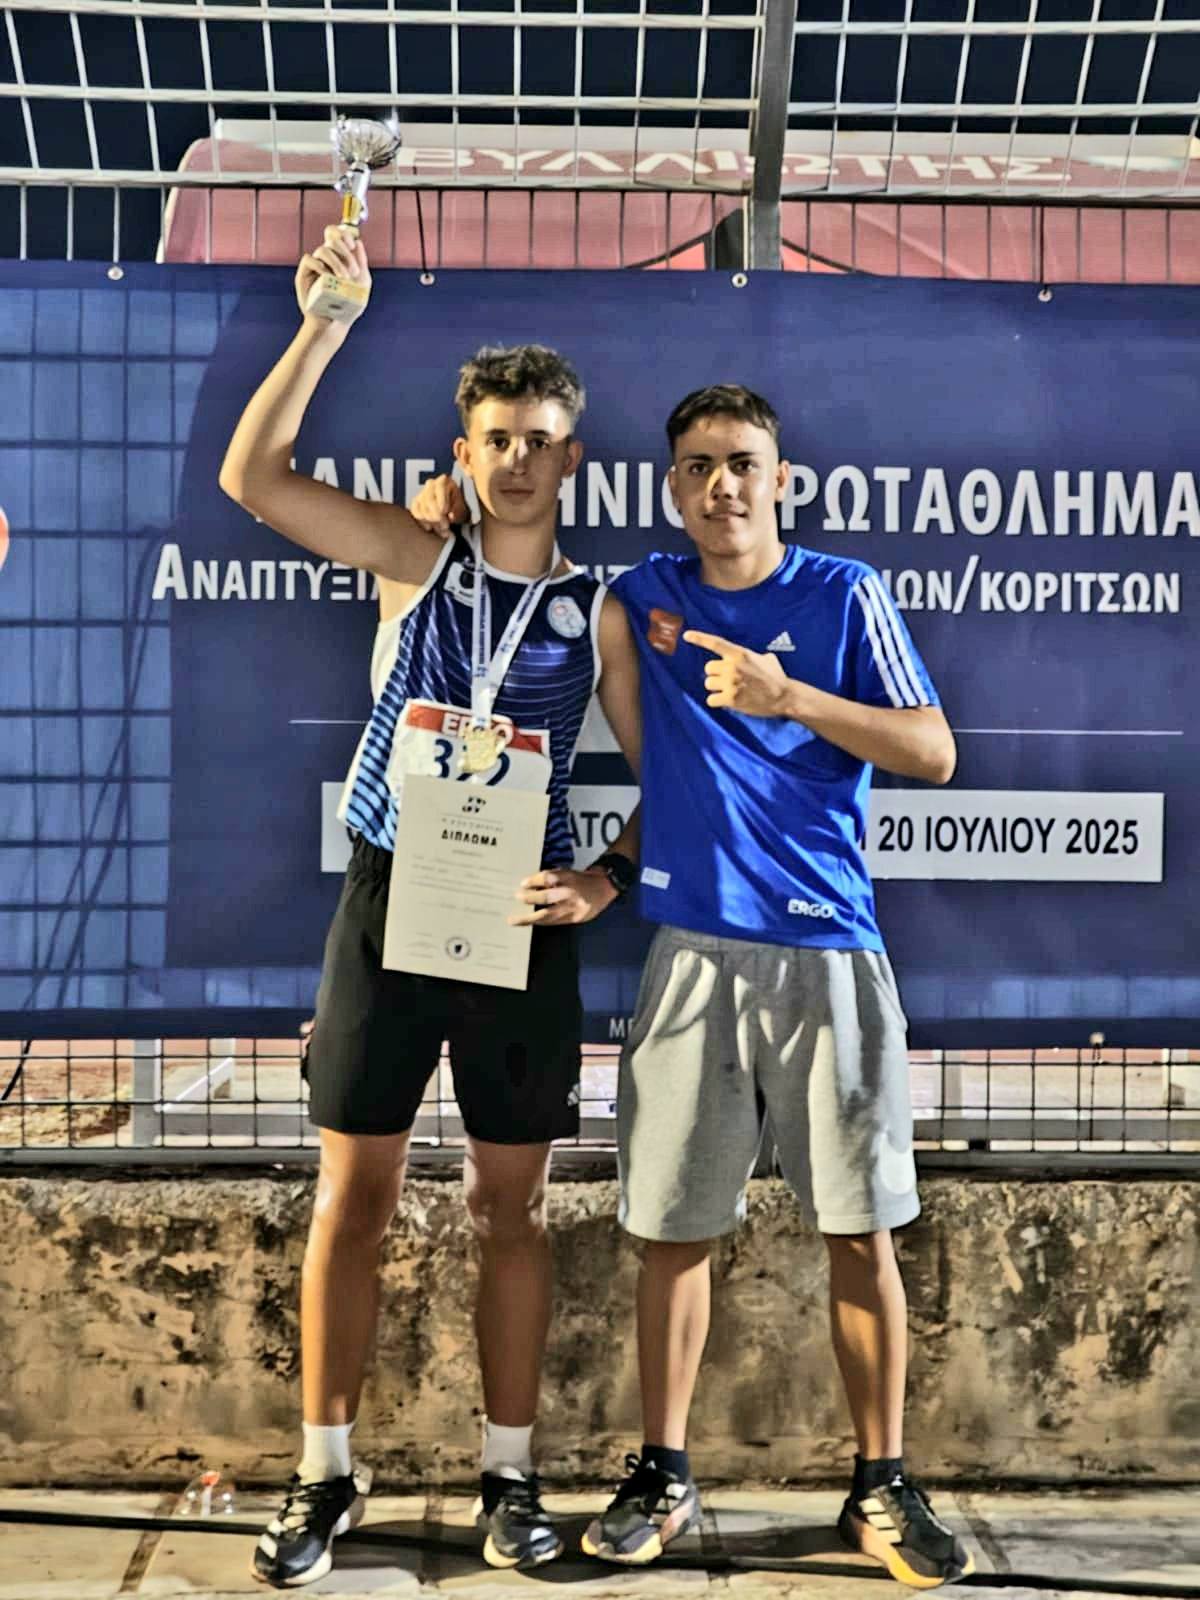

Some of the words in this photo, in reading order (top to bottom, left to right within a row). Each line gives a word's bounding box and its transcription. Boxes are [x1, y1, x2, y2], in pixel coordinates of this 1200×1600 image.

[781, 464, 1200, 537] ΡΩΤΑΘΛΗΜΑ
[882, 555, 1180, 613] ΙΩΝ/ΚΟΡΙΤΣΩΝ
[441, 828, 498, 847] ΔΙΠΛΩΜΑ
[878, 815, 914, 852] 20
[926, 816, 1056, 853] ΙΟΥΛΙΟΥ
[1065, 818, 1139, 855] 2025
[788, 898, 834, 919] ERGO
